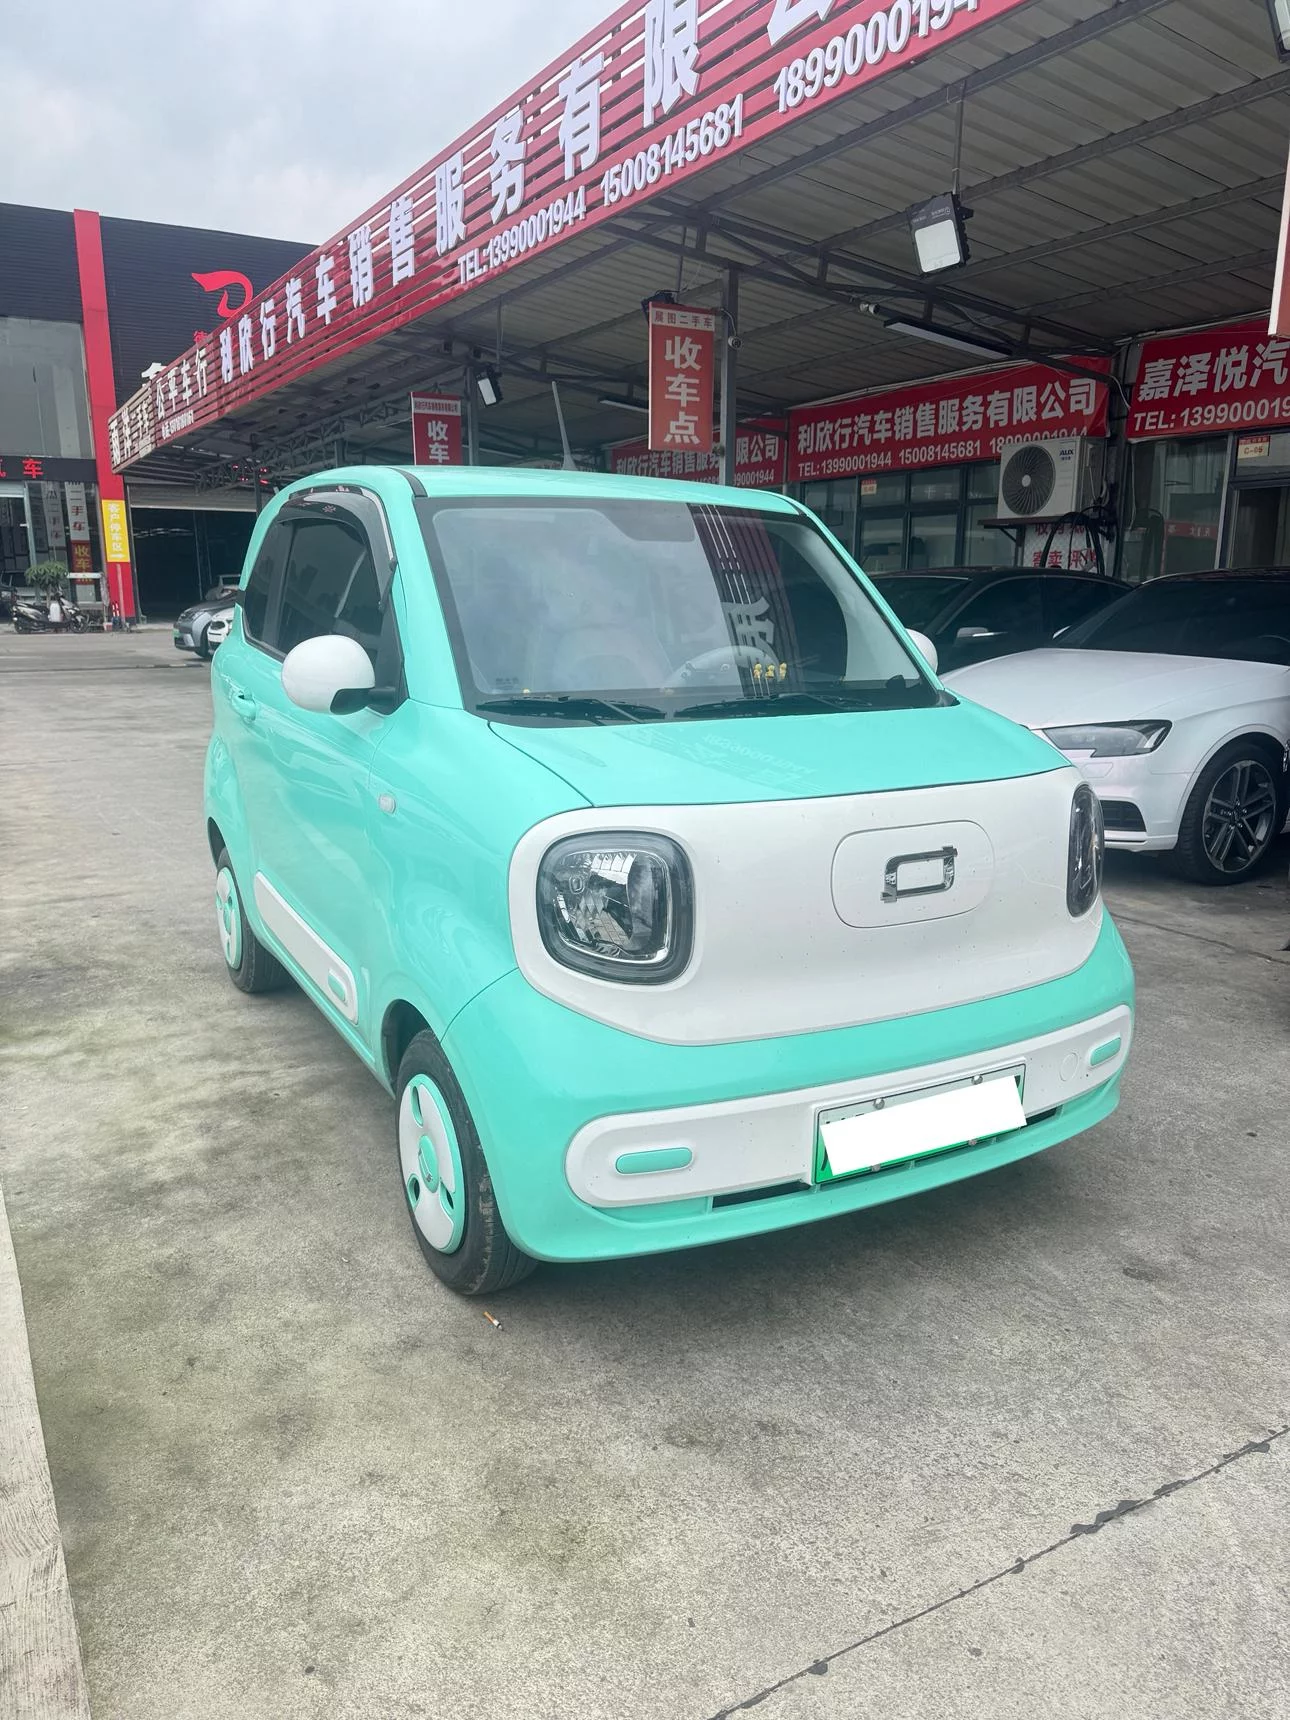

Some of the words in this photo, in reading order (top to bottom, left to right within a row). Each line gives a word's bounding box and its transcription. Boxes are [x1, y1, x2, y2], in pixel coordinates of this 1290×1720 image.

[458, 185, 586, 284] TEL:13990001944
[600, 93, 743, 206] 15008145681
[773, 0, 978, 113] 189900019
[664, 335, 702, 445] 收车点
[1137, 340, 1290, 401] 嘉泽悦汽
[428, 420, 450, 464] 收车
[797, 377, 1097, 455] 利欣行汽车销售服务有限公司
[899, 439, 981, 465] 15008145681
